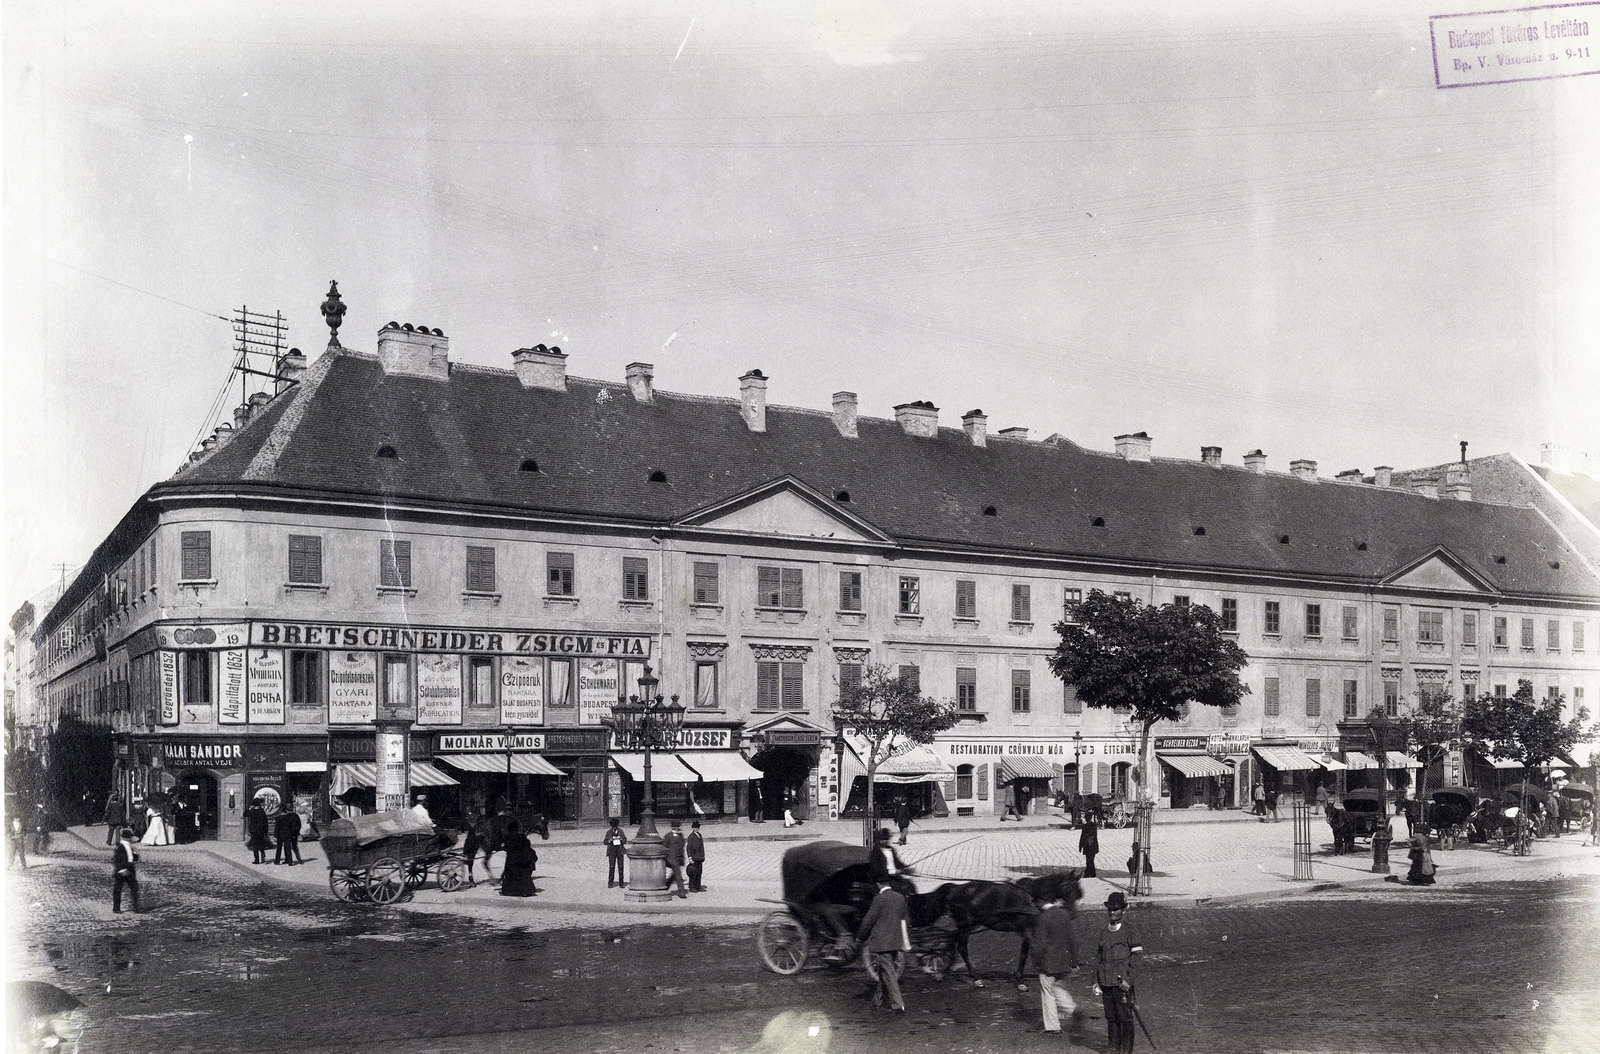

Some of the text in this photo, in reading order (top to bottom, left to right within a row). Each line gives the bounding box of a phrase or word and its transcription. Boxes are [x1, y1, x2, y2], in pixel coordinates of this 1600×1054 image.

[227, 634, 239, 645] 19
[261, 624, 504, 651] BRETSCHNEIDER
[607, 637, 645, 655] FIA
[163, 653, 174, 673] 1852
[227, 652, 243, 671] 1852
[444, 735, 493, 748] MOLNÁR
[680, 729, 728, 747] JÓZSEF
[164, 743, 243, 758] KÁLAI SÁNDOR
[950, 744, 1003, 755] RESTAURATION
